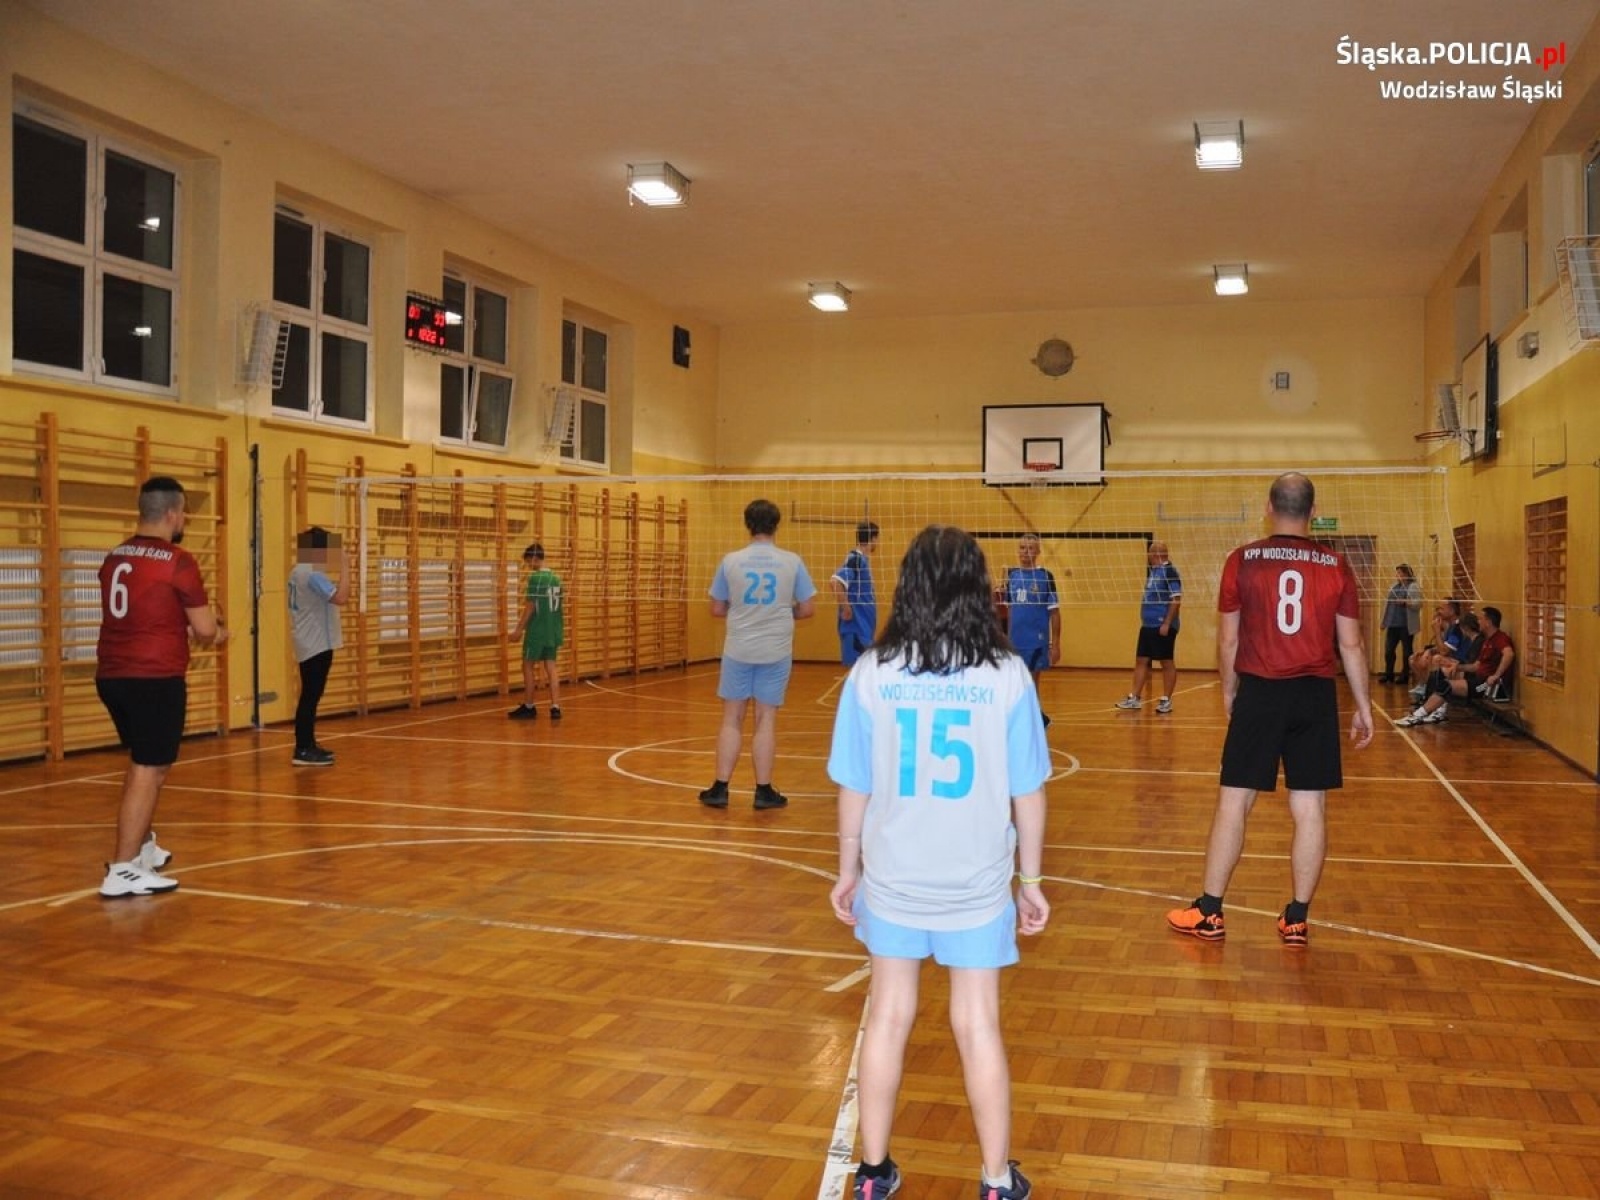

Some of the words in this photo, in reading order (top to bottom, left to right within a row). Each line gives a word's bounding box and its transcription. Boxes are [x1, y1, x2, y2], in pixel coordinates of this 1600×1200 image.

[1244, 549, 1261, 561] KPP
[1262, 547, 1310, 562] WODZISŁAW
[109, 562, 133, 619] 6
[743, 571, 777, 605] 23
[1276, 569, 1304, 635] 8
[879, 683, 995, 704] WODZISŁAWSKI
[895, 707, 975, 800] 15
